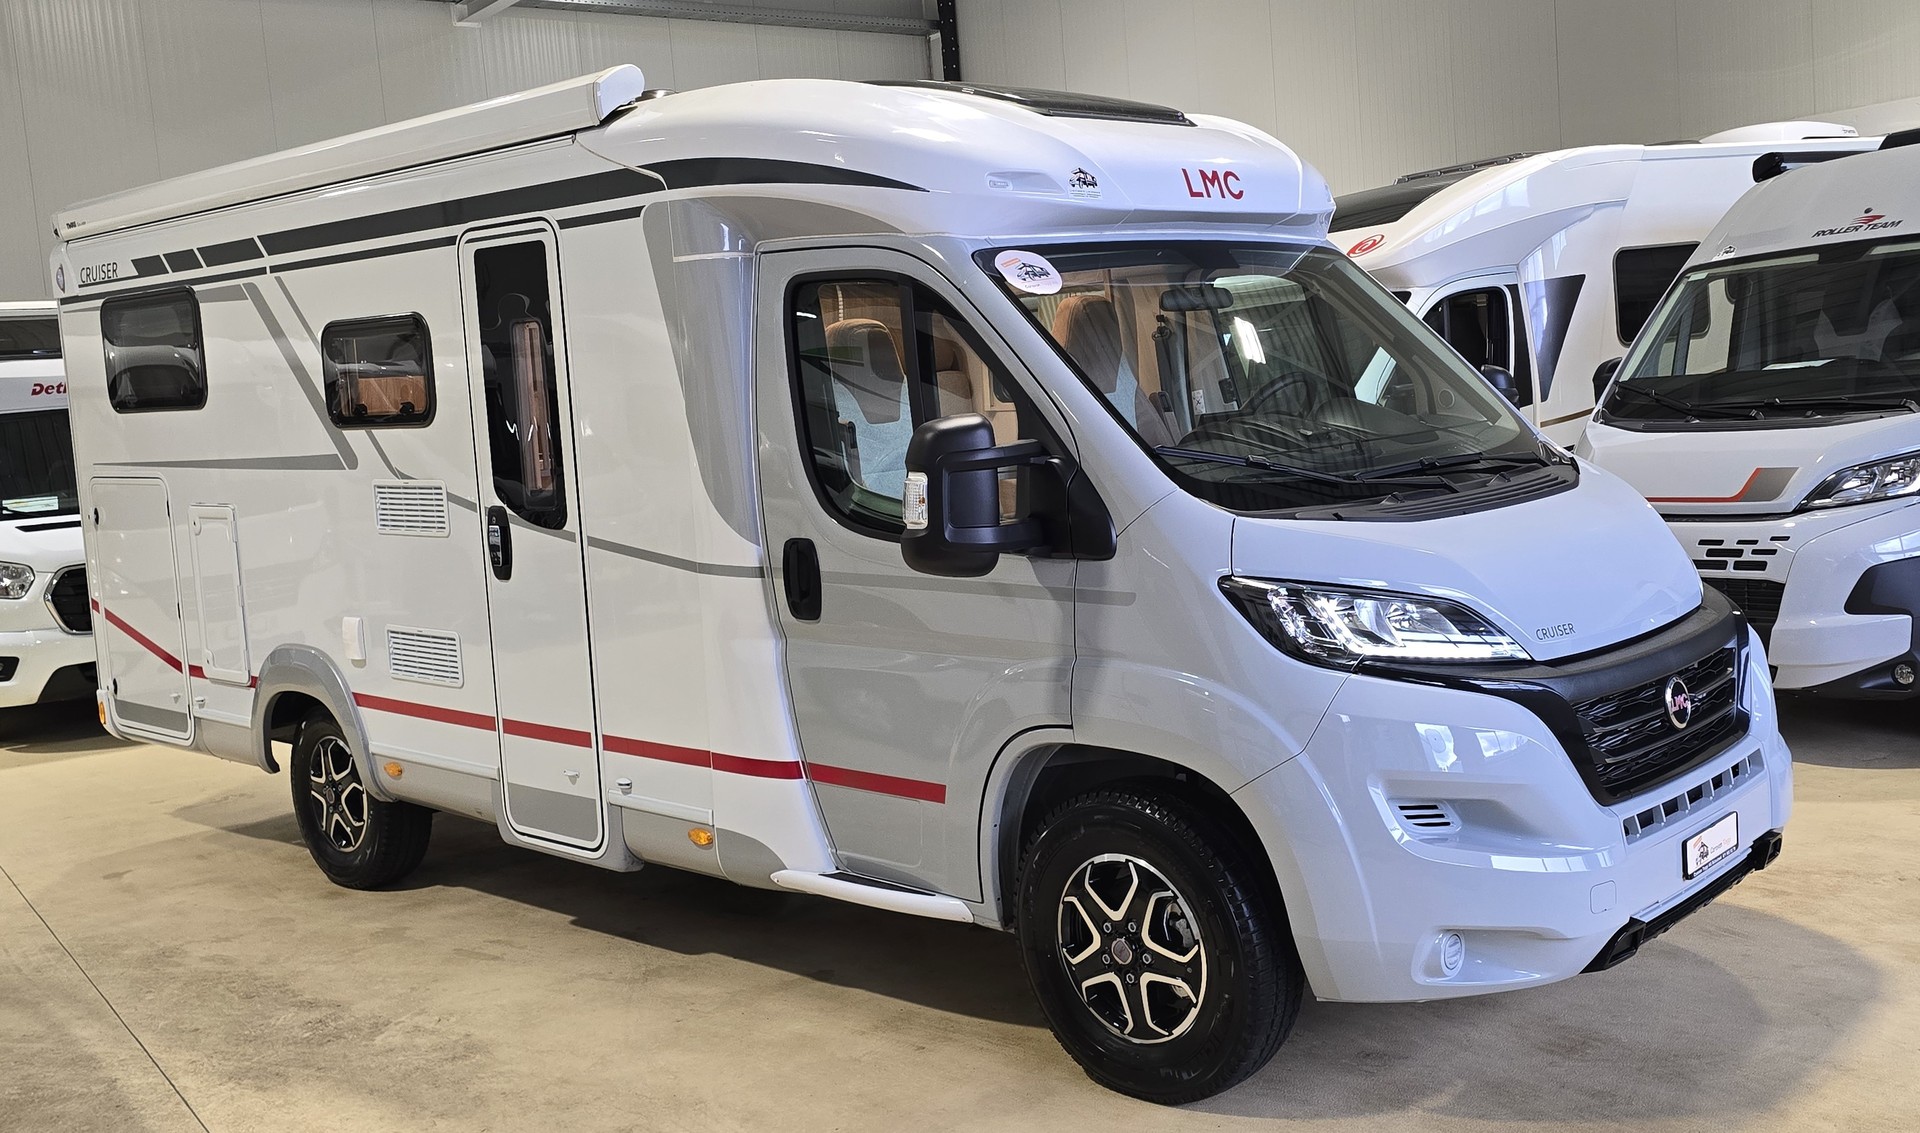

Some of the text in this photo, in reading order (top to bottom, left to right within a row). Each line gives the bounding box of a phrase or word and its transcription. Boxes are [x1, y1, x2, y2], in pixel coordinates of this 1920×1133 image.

[1182, 168, 1244, 200] LMC
[1811, 220, 1904, 238] ROLLER TEAM
[80, 262, 118, 283] CRUISER
[1535, 623, 1576, 640] CRUISER
[1671, 693, 1691, 712] LMC
